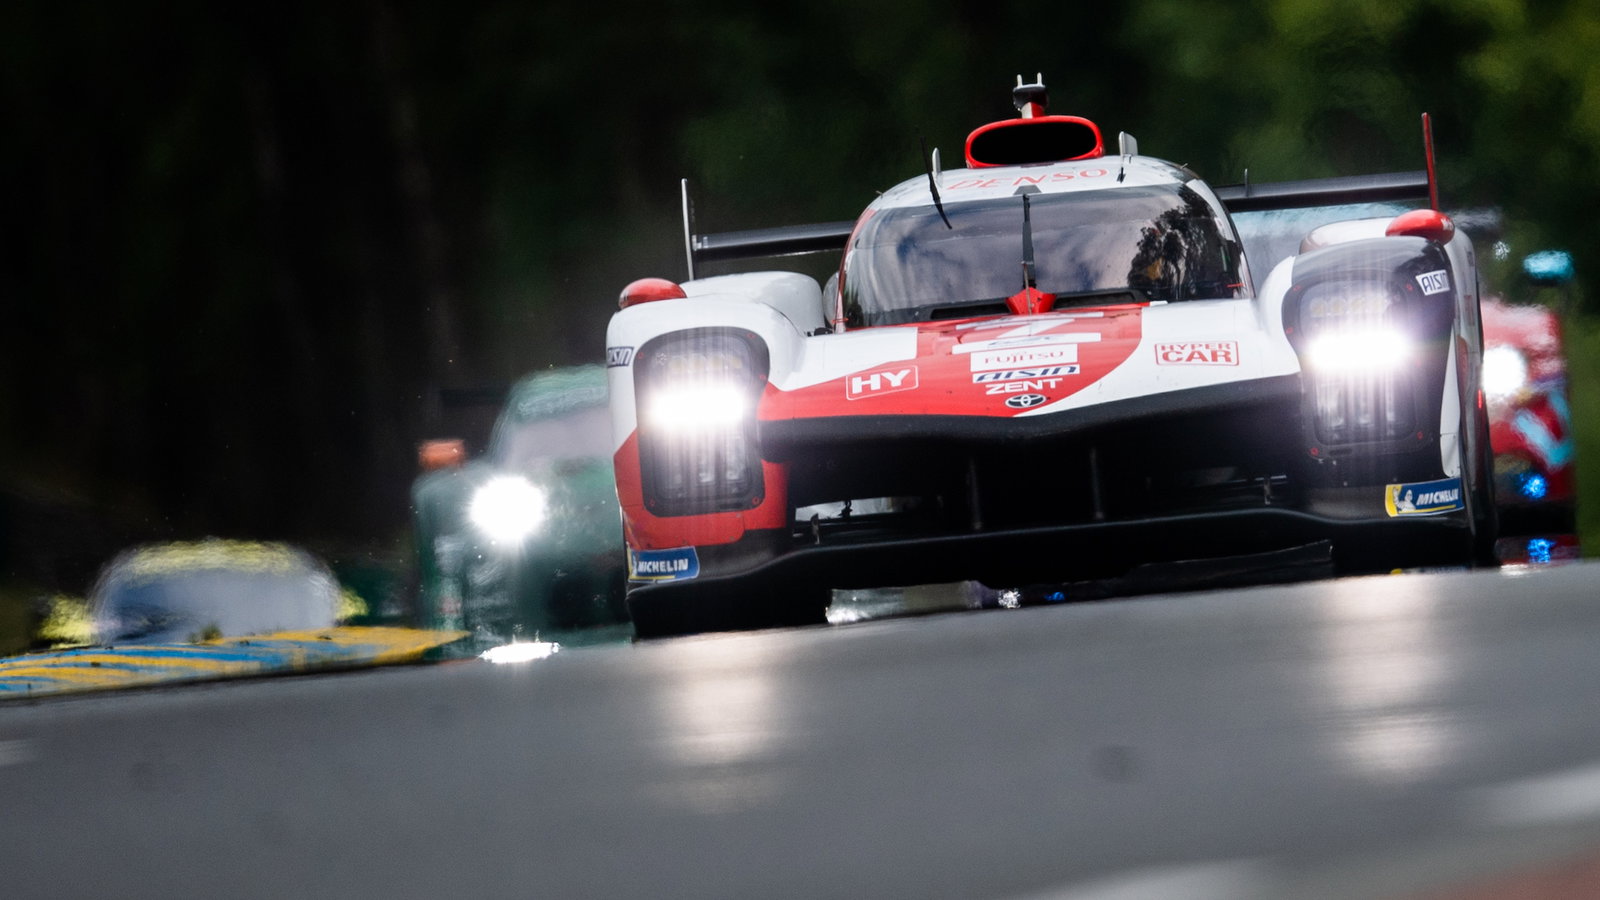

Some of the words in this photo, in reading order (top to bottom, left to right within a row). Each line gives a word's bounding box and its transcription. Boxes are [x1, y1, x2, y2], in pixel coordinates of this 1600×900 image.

[947, 168, 1108, 190] DENSO
[1161, 343, 1231, 351] HYPER
[1162, 350, 1232, 363] CAR
[852, 369, 911, 394] HY
[976, 365, 1077, 382] AISIN
[985, 377, 1064, 396] ZENT
[1415, 487, 1459, 506] MICHELIN
[637, 558, 689, 573] MICHELIN
